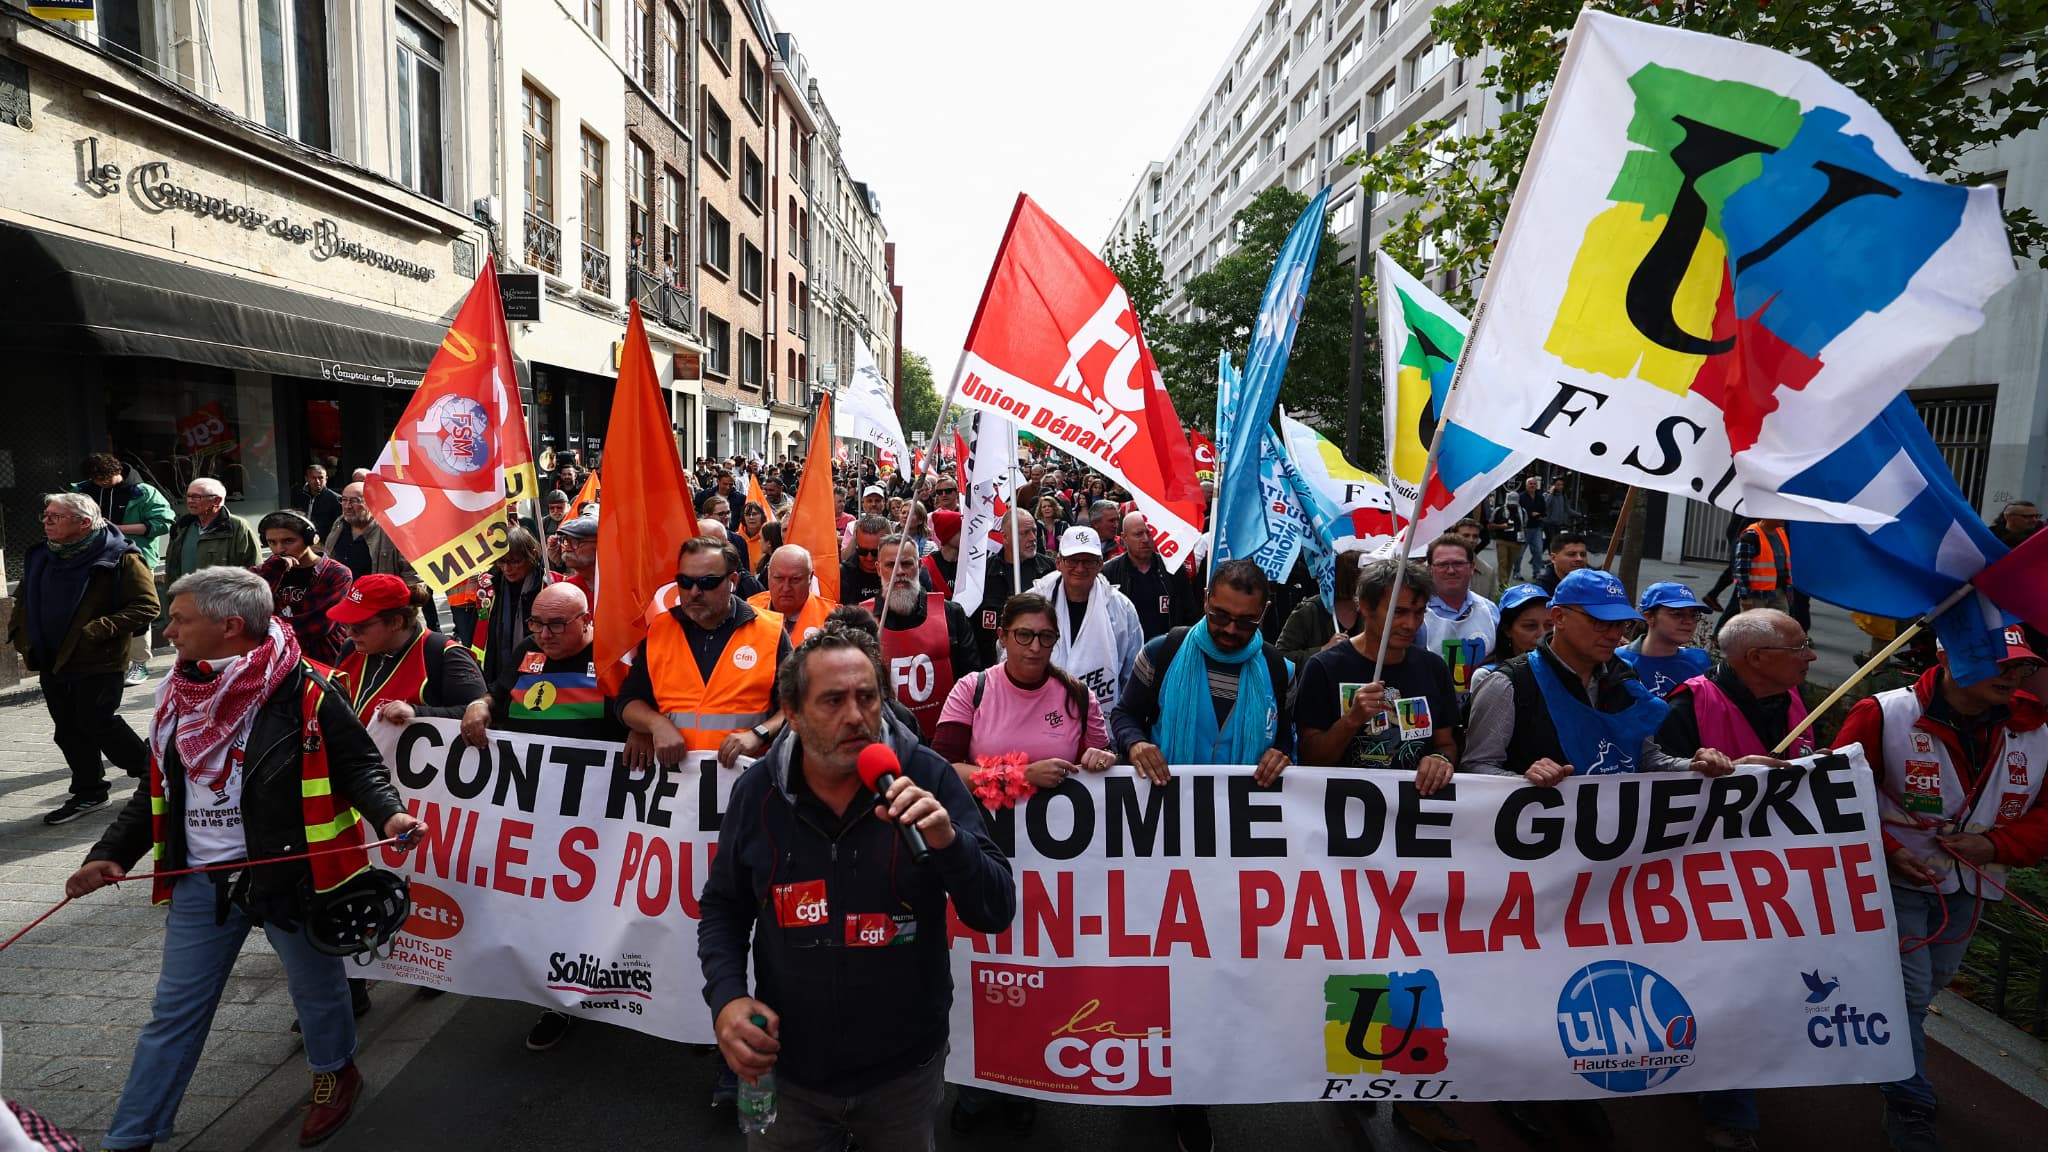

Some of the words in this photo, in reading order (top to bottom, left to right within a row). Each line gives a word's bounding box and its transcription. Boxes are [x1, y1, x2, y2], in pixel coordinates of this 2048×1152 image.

[89, 136, 121, 193] Le
[140, 162, 269, 224] Comptoir
[275, 217, 313, 242] des
[320, 361, 331, 379] Le
[333, 364, 371, 380] Comptoir
[961, 372, 1031, 419] Union
[453, 413, 472, 457] FSM
[2004, 631, 2024, 645] gt
[891, 654, 934, 702] FO
[1045, 711, 1058, 721] CFE
[1906, 774, 1940, 790] cgt
[2010, 774, 2028, 784] cgt
[395, 722, 682, 828] CONTRE
[1325, 778, 1456, 858] DE
[1494, 753, 1866, 861] GUERRE
[227, 816, 242, 828] ge
[796, 899, 829, 922] cgt
[1239, 869, 1541, 960] PAIX-LA
[1564, 843, 1886, 948] LIBERTE
[409, 901, 458, 928] fdt:
[860, 927, 885, 944] cgt
[394, 935, 452, 960] AUTS-DE
[390, 949, 446, 972] FRANCE
[547, 951, 652, 992] Solidaires
[979, 969, 1045, 989] nord
[985, 984, 1027, 1008] 59
[580, 1000, 620, 1010] Nord
[628, 1001, 643, 1016] 59
[1807, 1003, 1891, 1048] cftc
[1044, 1027, 1171, 1091] cgt
[1573, 1053, 1689, 1071] Hauts-de-France
[981, 1071, 1006, 1080] union
[1007, 1074, 1080, 1091] départementale
[1320, 1078, 1459, 1100] F.S.U.
